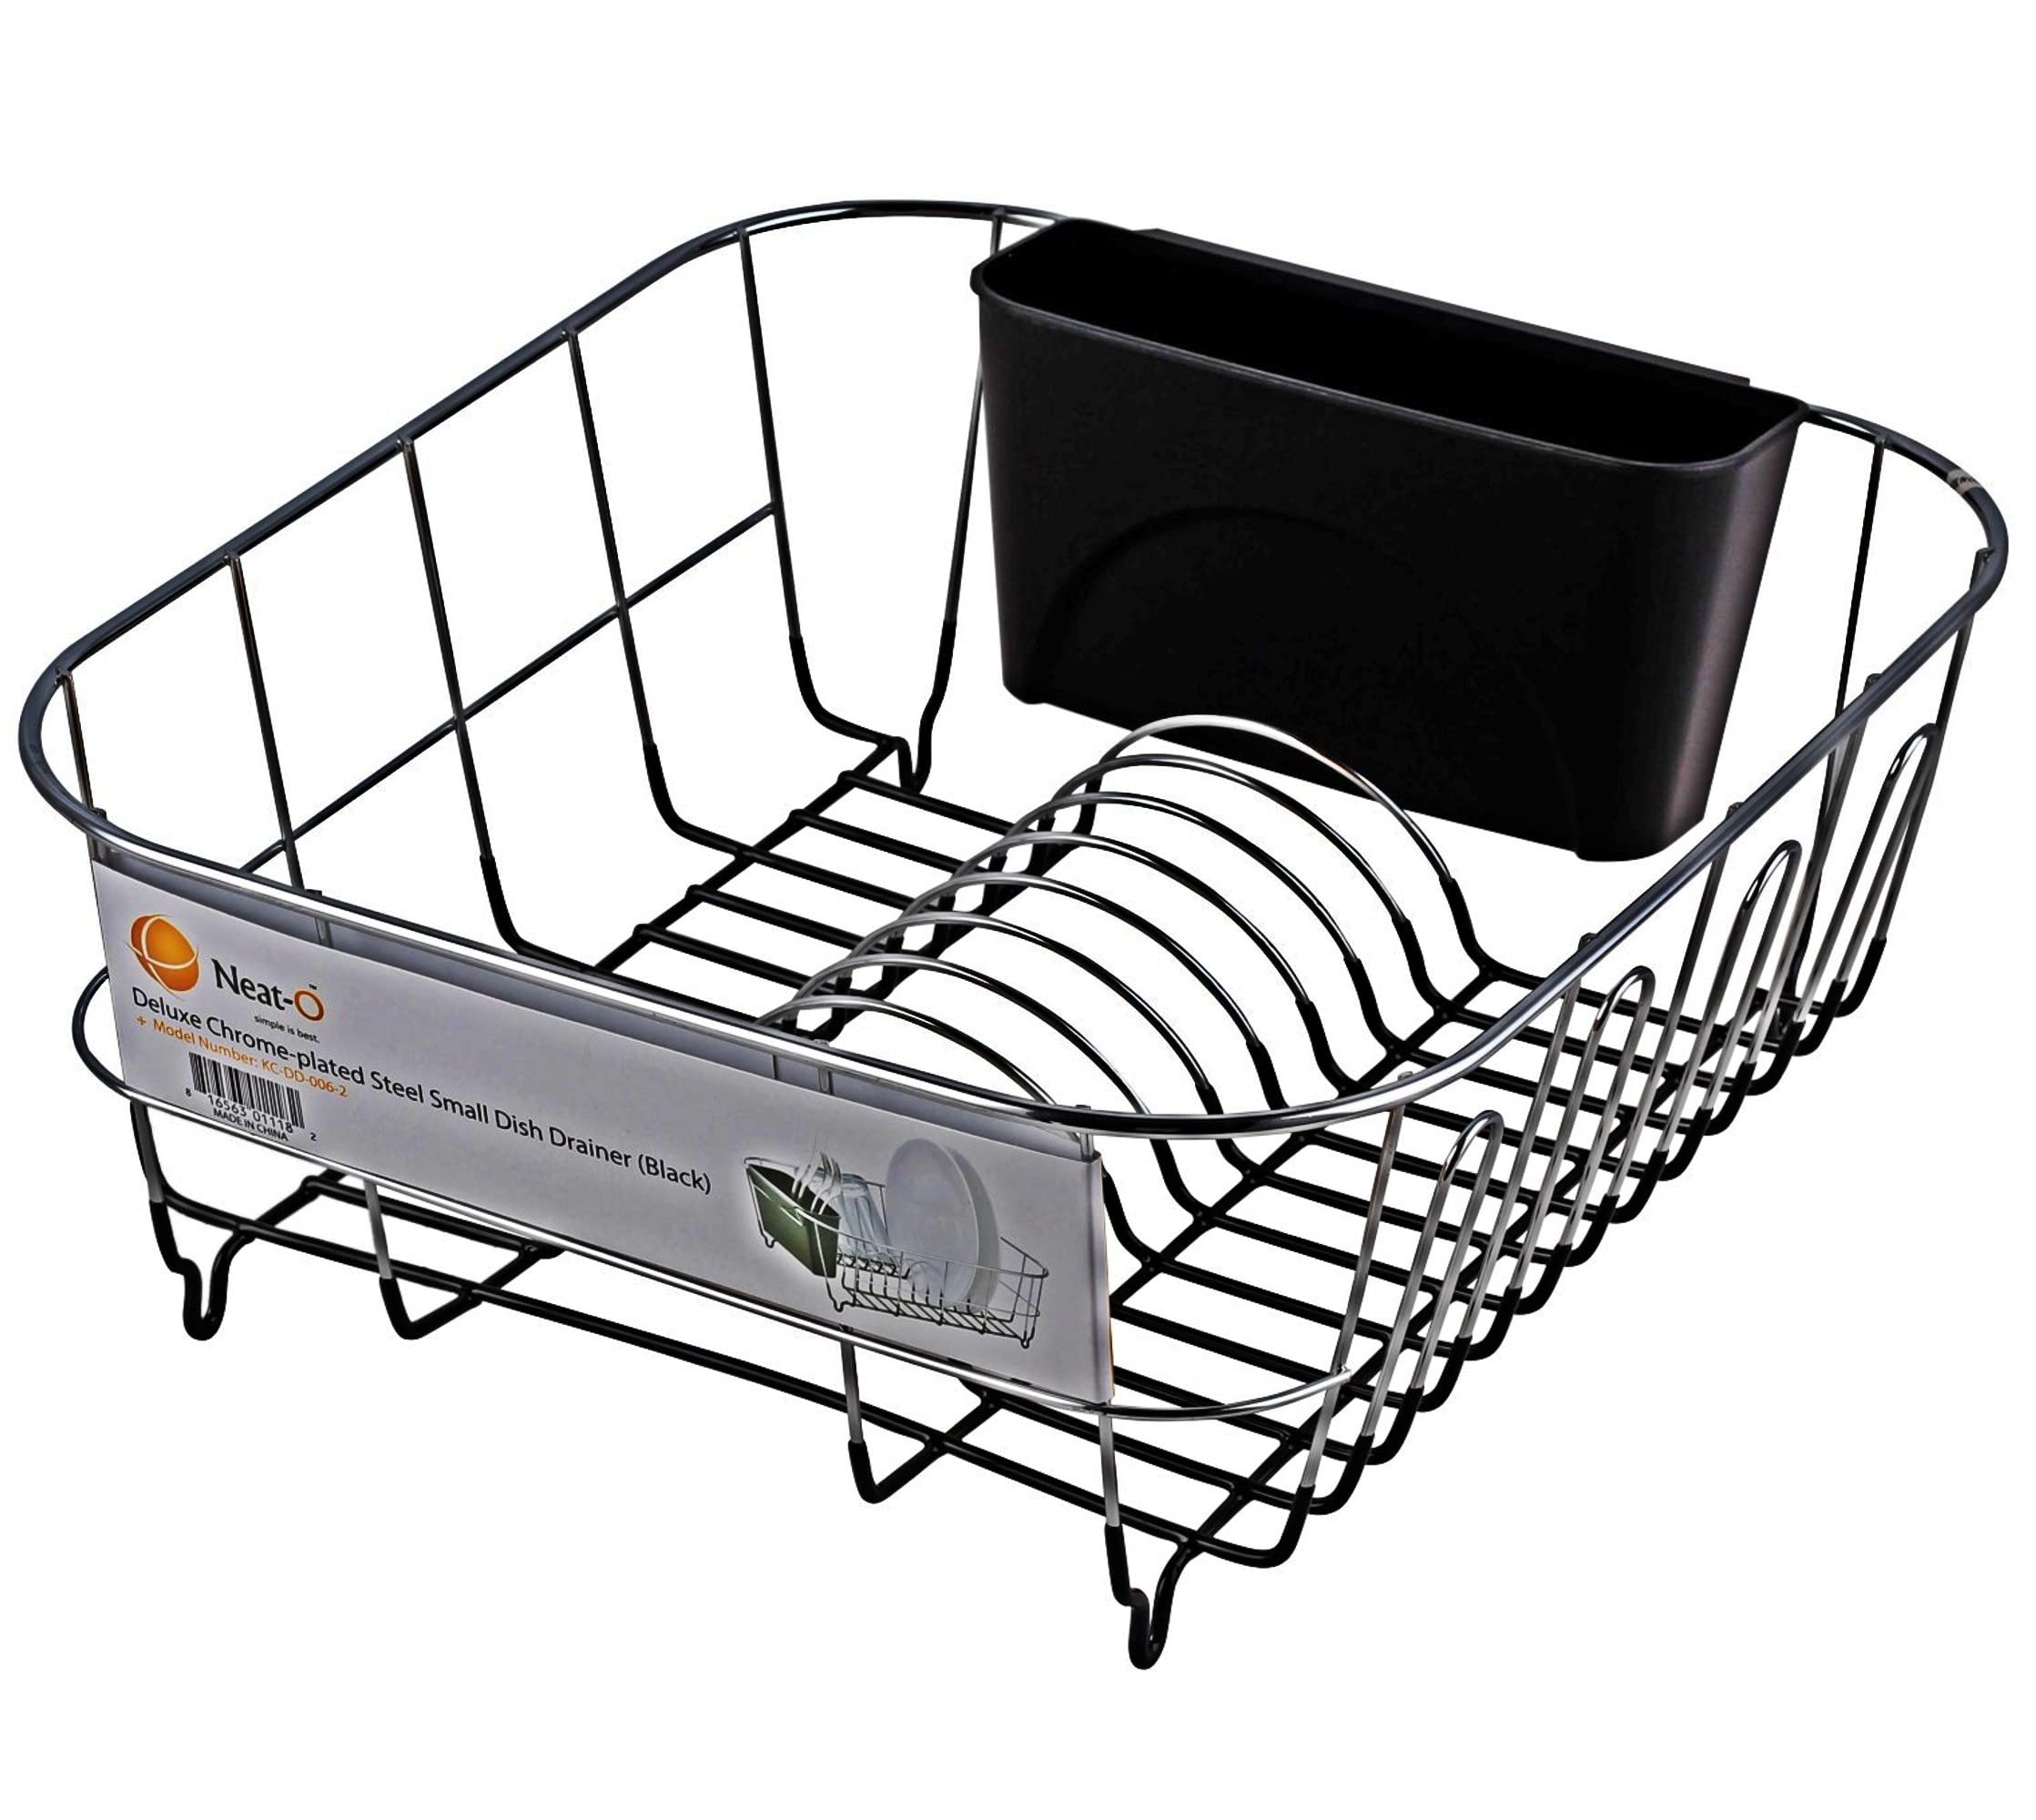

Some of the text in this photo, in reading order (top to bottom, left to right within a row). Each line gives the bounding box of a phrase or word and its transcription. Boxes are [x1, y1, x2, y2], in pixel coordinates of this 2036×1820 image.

[254, 1016, 320, 1043] simple is best.
[153, 1018, 196, 1045] Model
[198, 1036, 258, 1067] Number:
[261, 1058, 349, 1097] KC-DD-006-2
[132, 986, 712, 1195] Deluxe Chrome-plated Steel Small Dish Drainer (Black)
[208, 1094, 247, 1117] 16563
[252, 1110, 293, 1134] 01118
[309, 1132, 317, 1142] 2
[213, 1107, 289, 1141] MADE IN CHINA
